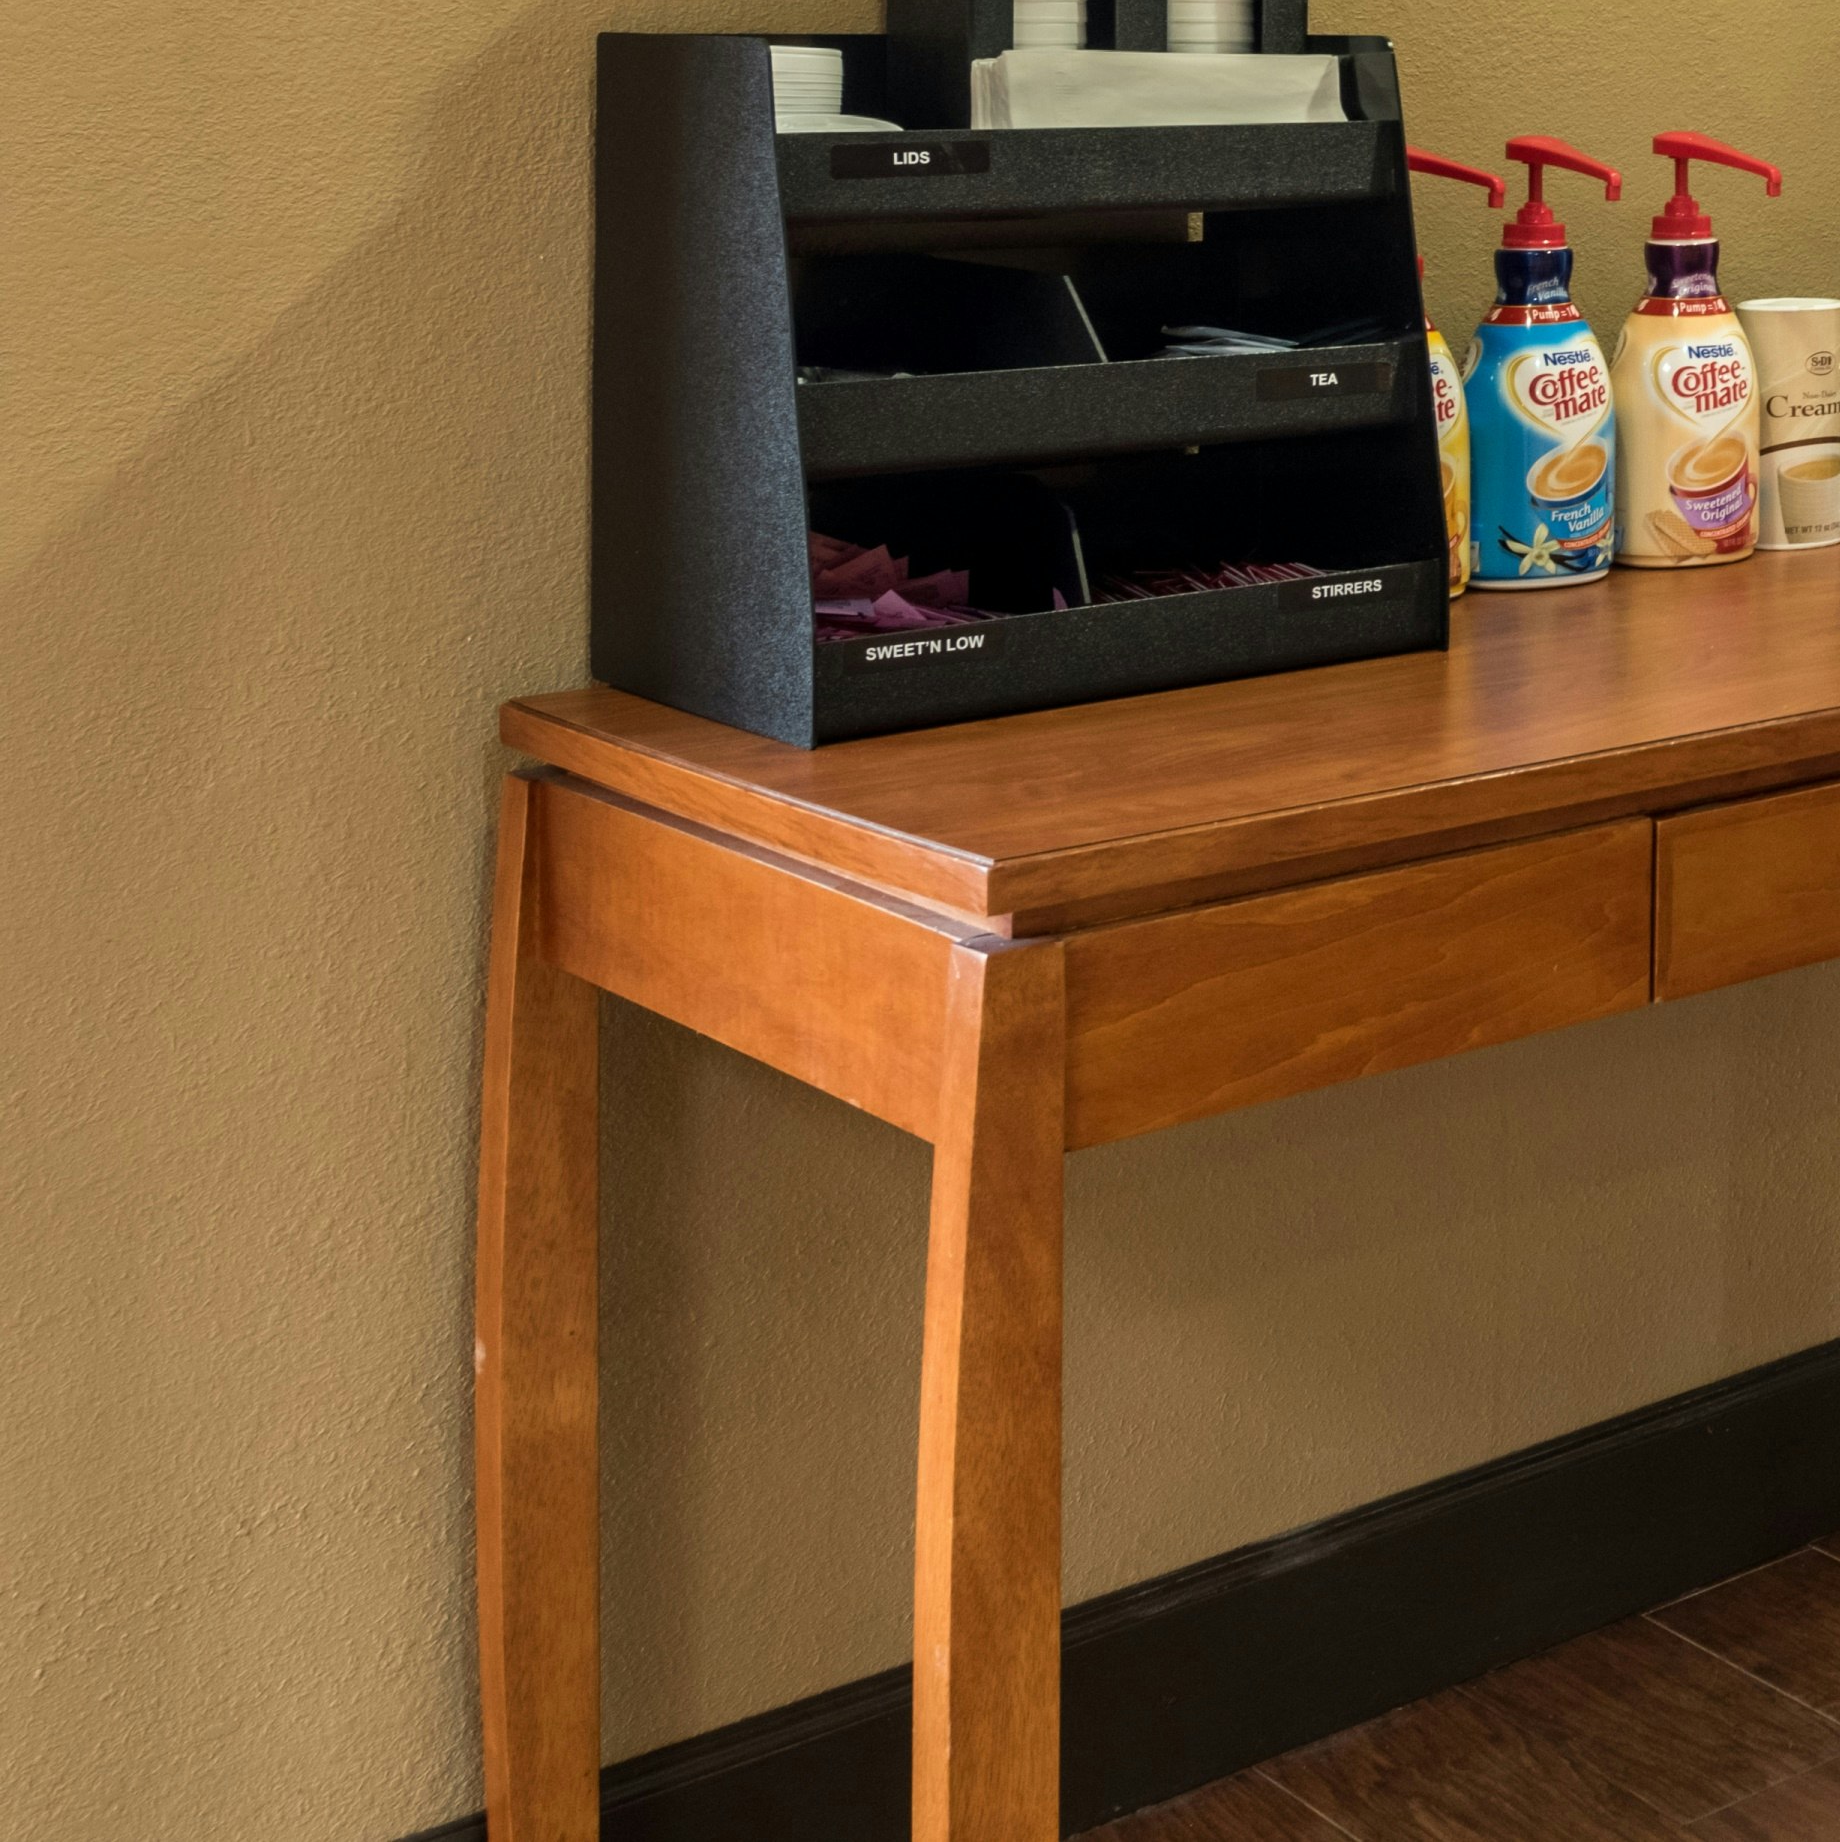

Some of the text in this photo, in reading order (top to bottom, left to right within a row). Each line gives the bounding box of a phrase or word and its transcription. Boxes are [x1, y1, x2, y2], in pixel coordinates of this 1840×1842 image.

[893, 151, 931, 166] LIDS
[1532, 308, 1560, 321] Pump
[1680, 301, 1707, 314] Pump
[1309, 372, 1339, 387] TEA
[1553, 384, 1607, 422] mate
[1695, 379, 1748, 414] mate
[1685, 482, 1742, 511] Sweetened
[1700, 494, 1744, 521] Original
[1551, 502, 1591, 522] French
[1568, 506, 1604, 533] Vanilla
[1311, 579, 1383, 599] STIRRERS
[865, 634, 985, 661] SWEET'N LOW
